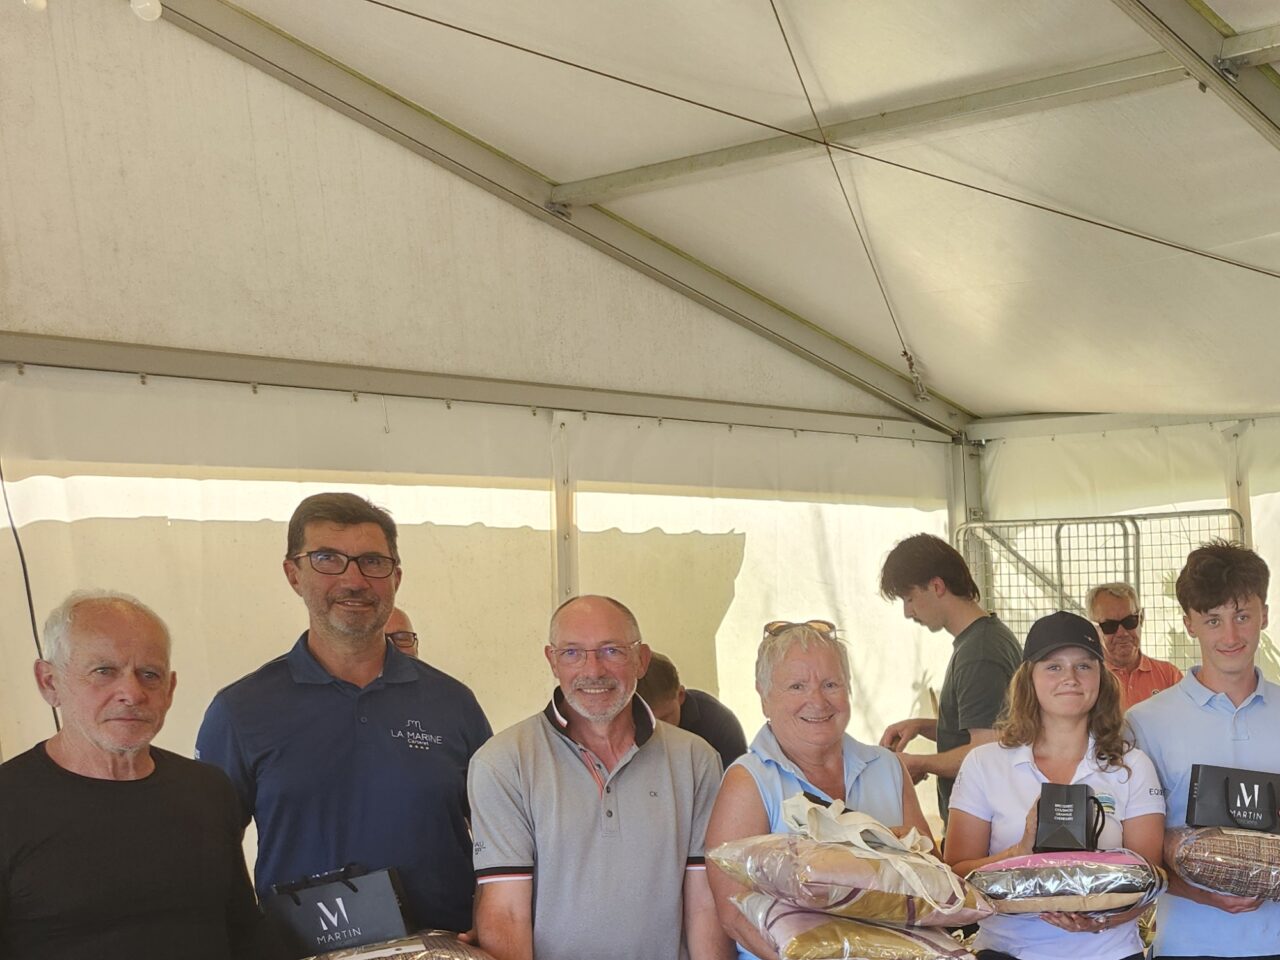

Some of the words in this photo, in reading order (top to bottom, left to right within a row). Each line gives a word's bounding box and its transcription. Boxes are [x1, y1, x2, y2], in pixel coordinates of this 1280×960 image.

[390, 729, 404, 738] LA
[407, 731, 443, 745] MARINE
[1229, 809, 1263, 821] MARTIN
[316, 927, 362, 945] MARTIN
